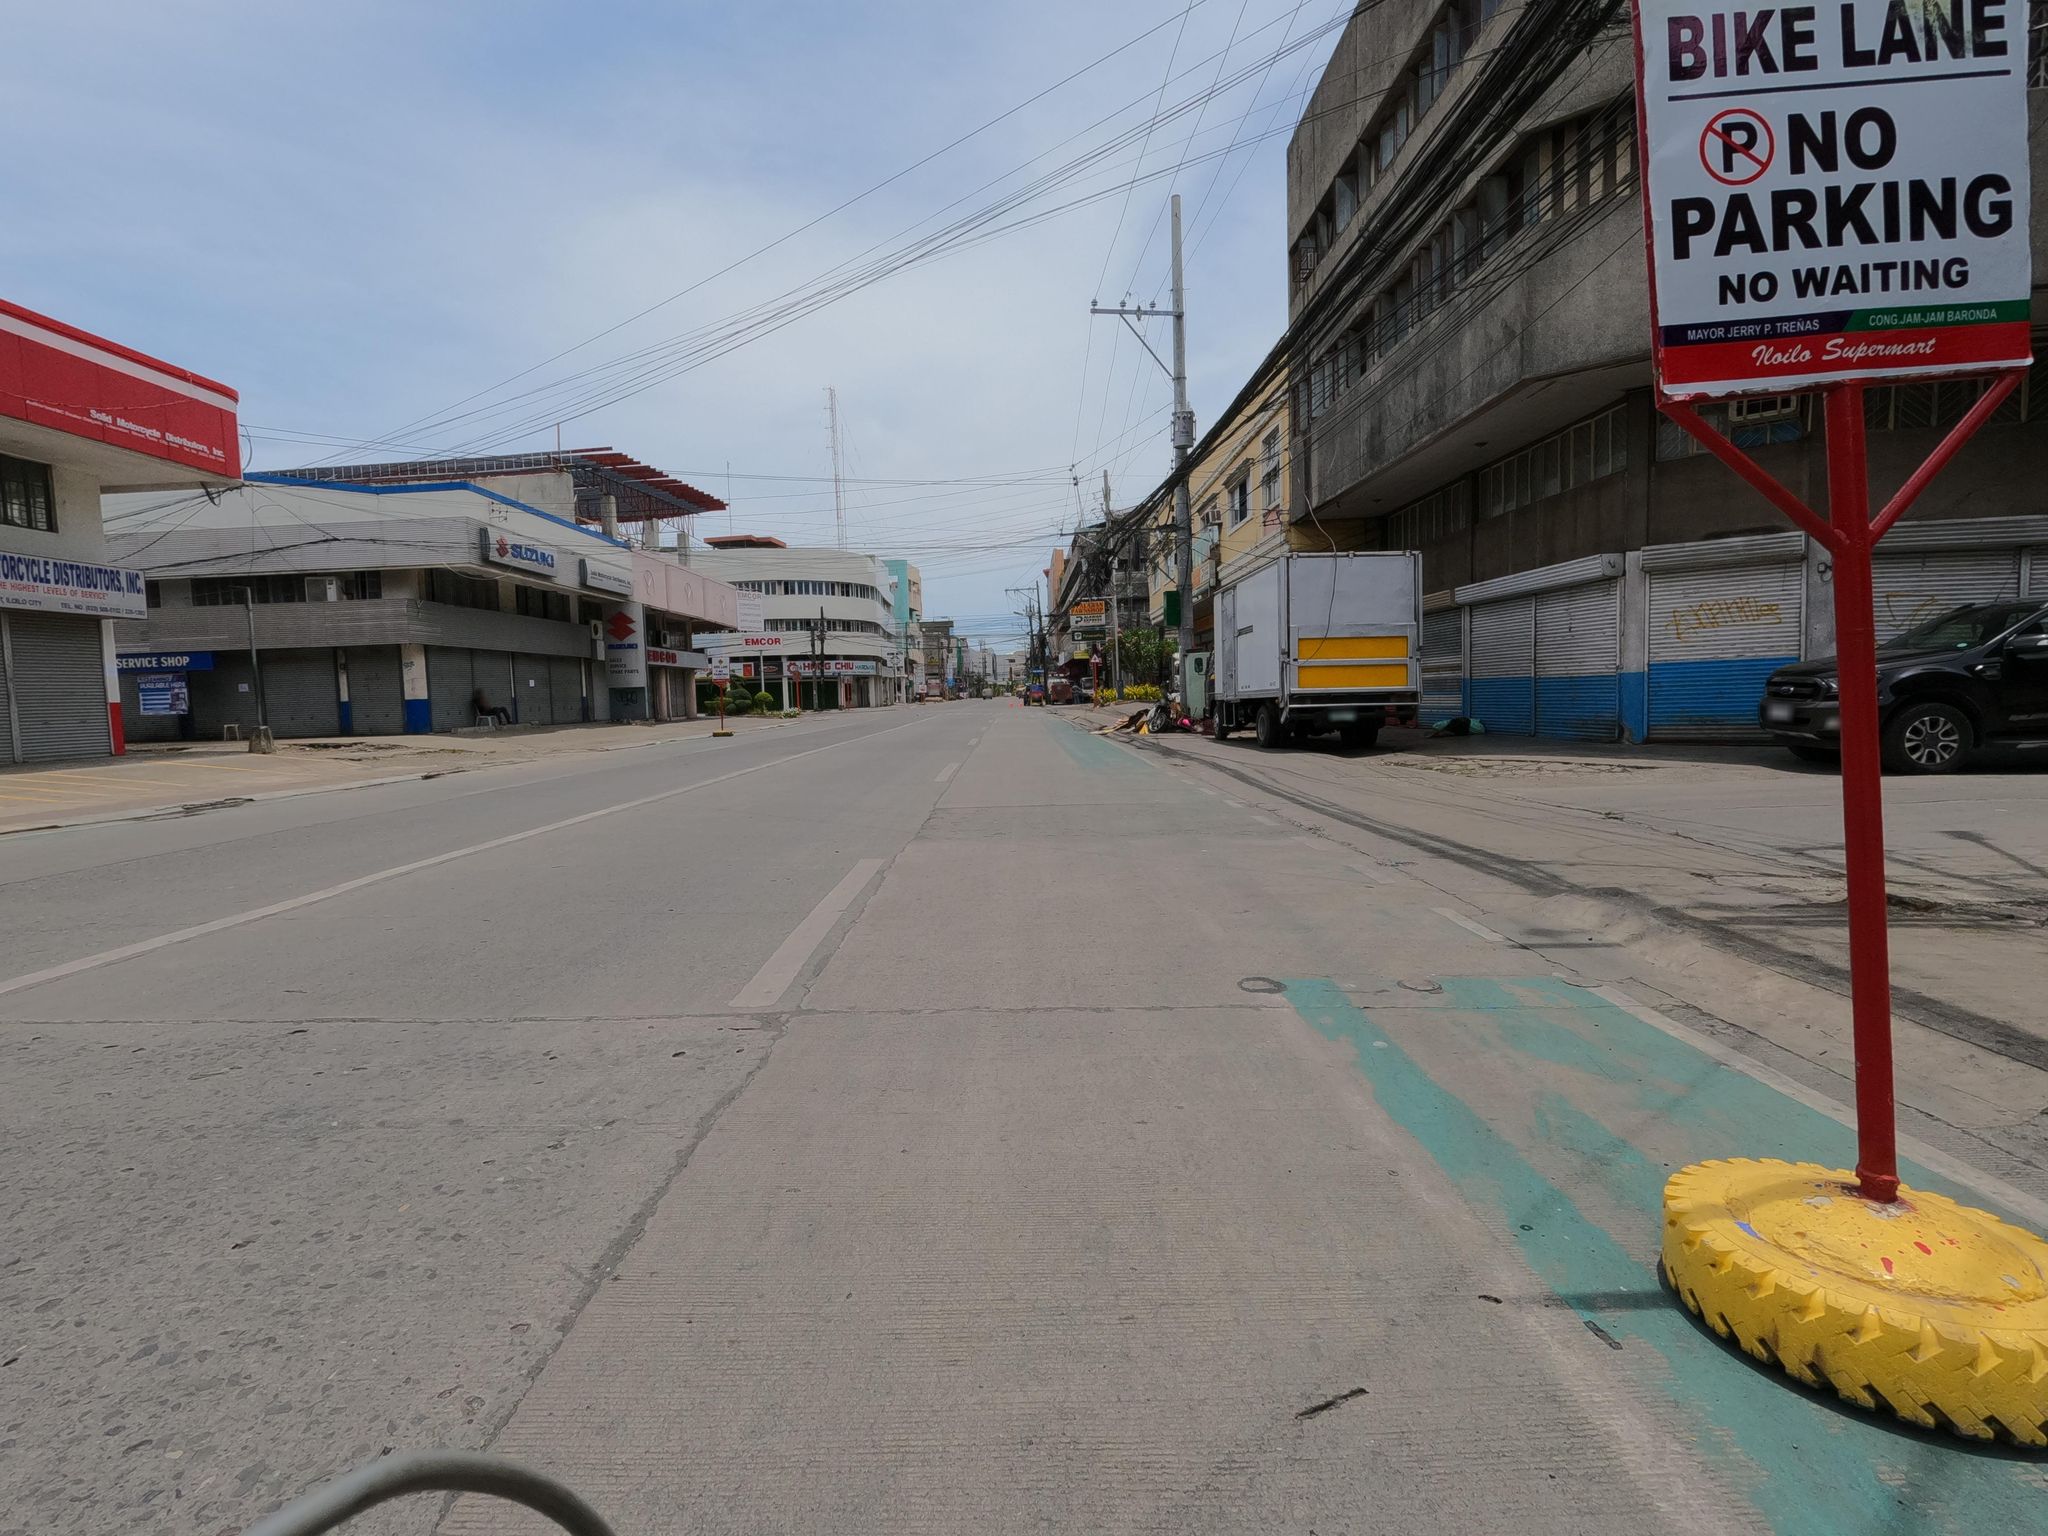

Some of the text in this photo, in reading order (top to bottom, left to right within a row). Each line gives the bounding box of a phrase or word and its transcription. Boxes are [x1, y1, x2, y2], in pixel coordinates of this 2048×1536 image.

[1667, 0, 2009, 82] BIKE LANE
[1787, 106, 1897, 175] NO
[1671, 173, 2013, 260] PARKING
[1719, 257, 1969, 306] NO WAITING
[1687, 318, 1820, 340] MAYOR JERRY P. TREÑAS
[1901, 311, 1945, 325] JAM-JAM
[1946, 308, 1998, 322] BARONDA
[1751, 337, 1937, 367] Iloilo Supermart
[90, 409, 112, 424] Solid
[116, 417, 161, 438] Motorcycle
[165, 432, 210, 454] Distributors,
[511, 543, 555, 568] SUZUKI
[0, 554, 144, 597] ORCYCLE DISTRIBUTORS, INC.
[10, 583, 39, 593] HIGHEST
[43, 586, 67, 596] LEVELS
[70, 589, 78, 597] OF
[28, 599, 42, 607] CITY
[744, 637, 781, 646] EMCOR
[116, 656, 190, 669] SERVICE SHOP
[834, 662, 854, 670] CHIU
